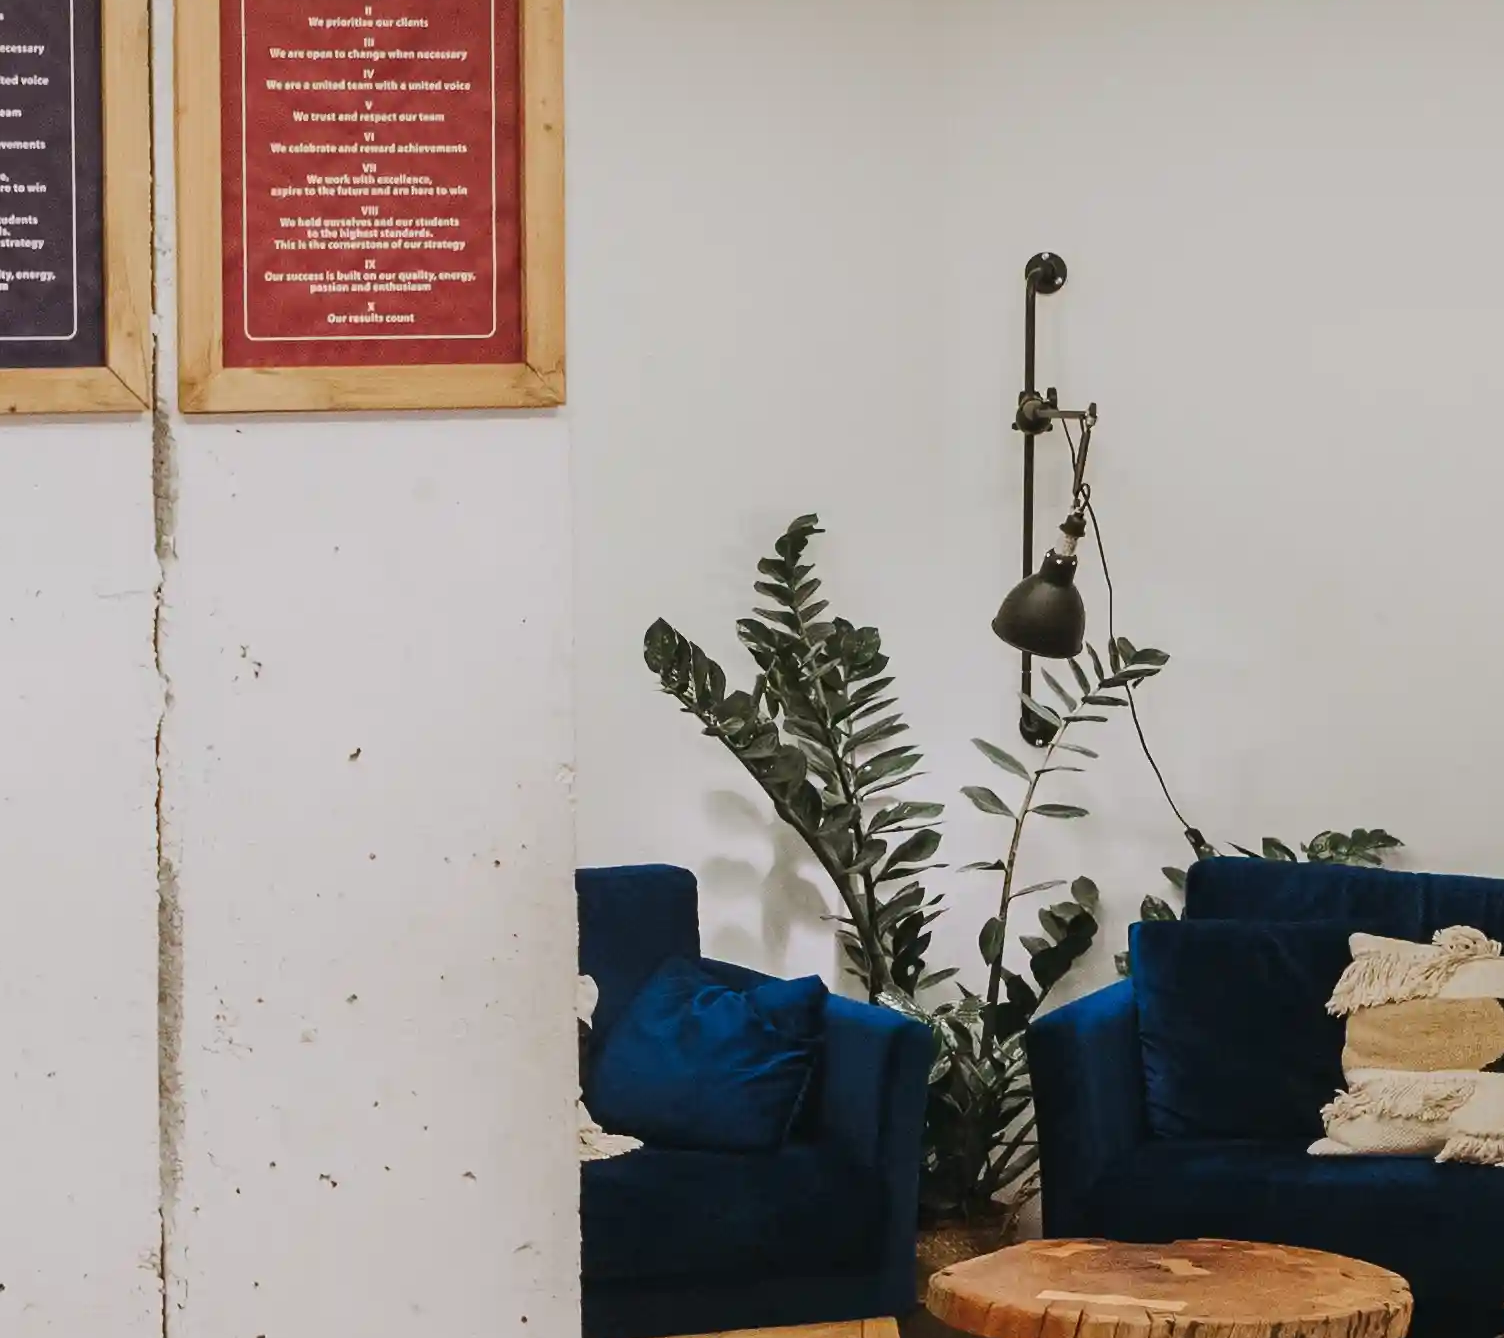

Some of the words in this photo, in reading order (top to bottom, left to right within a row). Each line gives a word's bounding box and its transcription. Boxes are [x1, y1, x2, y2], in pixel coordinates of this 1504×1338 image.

[21, 75, 49, 85] voice
[307, 174, 323, 186] We
[324, 174, 351, 186] work
[352, 174, 375, 184] with
[377, 174, 432, 186] excellence,
[271, 186, 303, 198] aspire
[304, 187, 316, 196] to
[317, 186, 335, 196] the
[337, 186, 369, 196] future
[371, 186, 391, 195] and
[393, 187, 409, 195] are
[411, 186, 434, 195] here
[436, 187, 448, 195] to
[449, 186, 467, 195] win
[280, 217, 296, 227] We
[297, 217, 322, 227] hold
[323, 217, 372, 228] ourselves
[374, 217, 393, 227] and
[395, 219, 413, 227] our
[415, 217, 459, 227] students
[307, 229, 319, 240] to
[320, 228, 338, 238] the
[339, 228, 378, 240] highest
[380, 228, 433, 240] standards.
[274, 239, 296, 250] This
[298, 239, 307, 249] is
[308, 239, 326, 249] the
[328, 239, 389, 249] cornerstone
[391, 239, 402, 249] of
[403, 241, 422, 249] our
[423, 240, 465, 251] strategy
[265, 271, 284, 281] Our
[286, 273, 324, 282] success
[326, 270, 335, 281] is
[337, 270, 361, 281] built
[398, 270, 437, 282] quality,
[438, 272, 476, 282] energy,
[327, 313, 347, 324] Our
[349, 313, 384, 323] results
[386, 314, 414, 323] count
